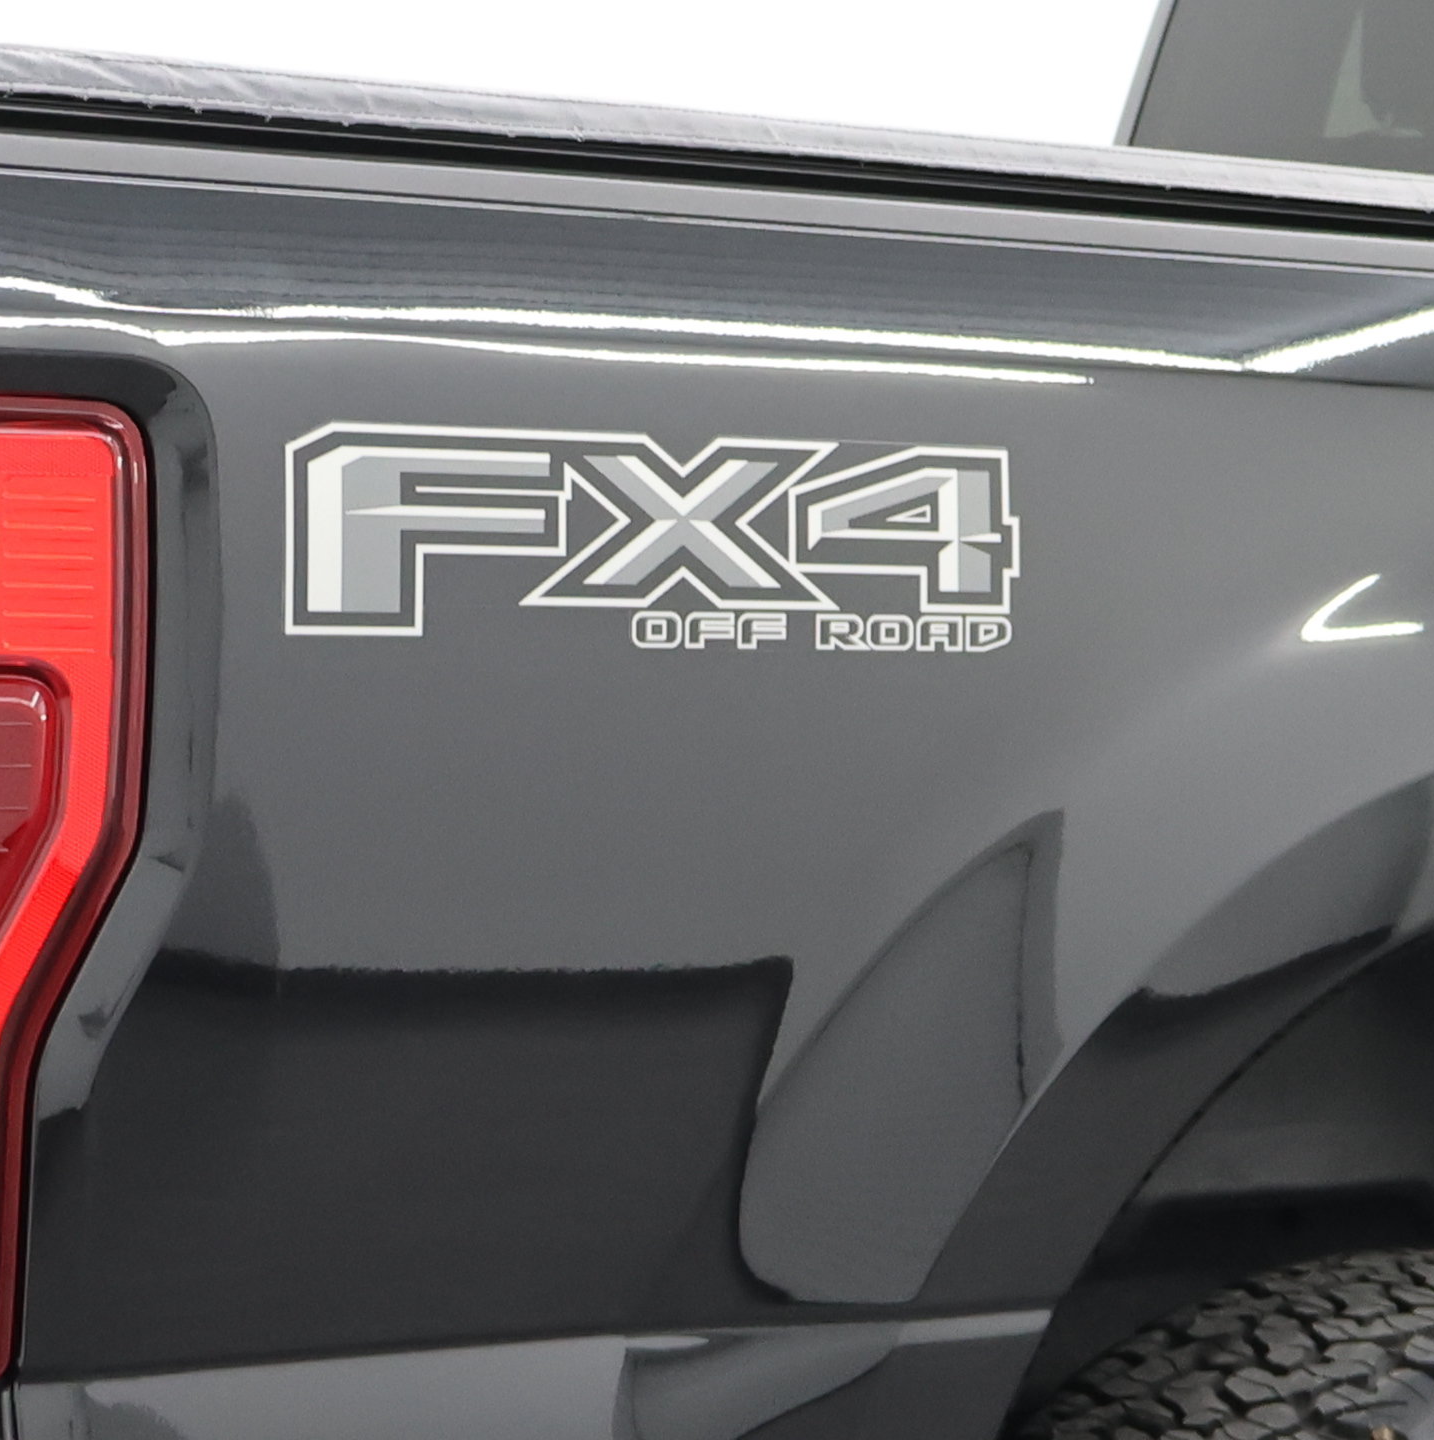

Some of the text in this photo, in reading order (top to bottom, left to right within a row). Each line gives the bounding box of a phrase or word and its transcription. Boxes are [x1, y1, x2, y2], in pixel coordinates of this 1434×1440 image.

[284, 421, 1021, 637] FX4
[630, 610, 1013, 652] OFF ROAD
